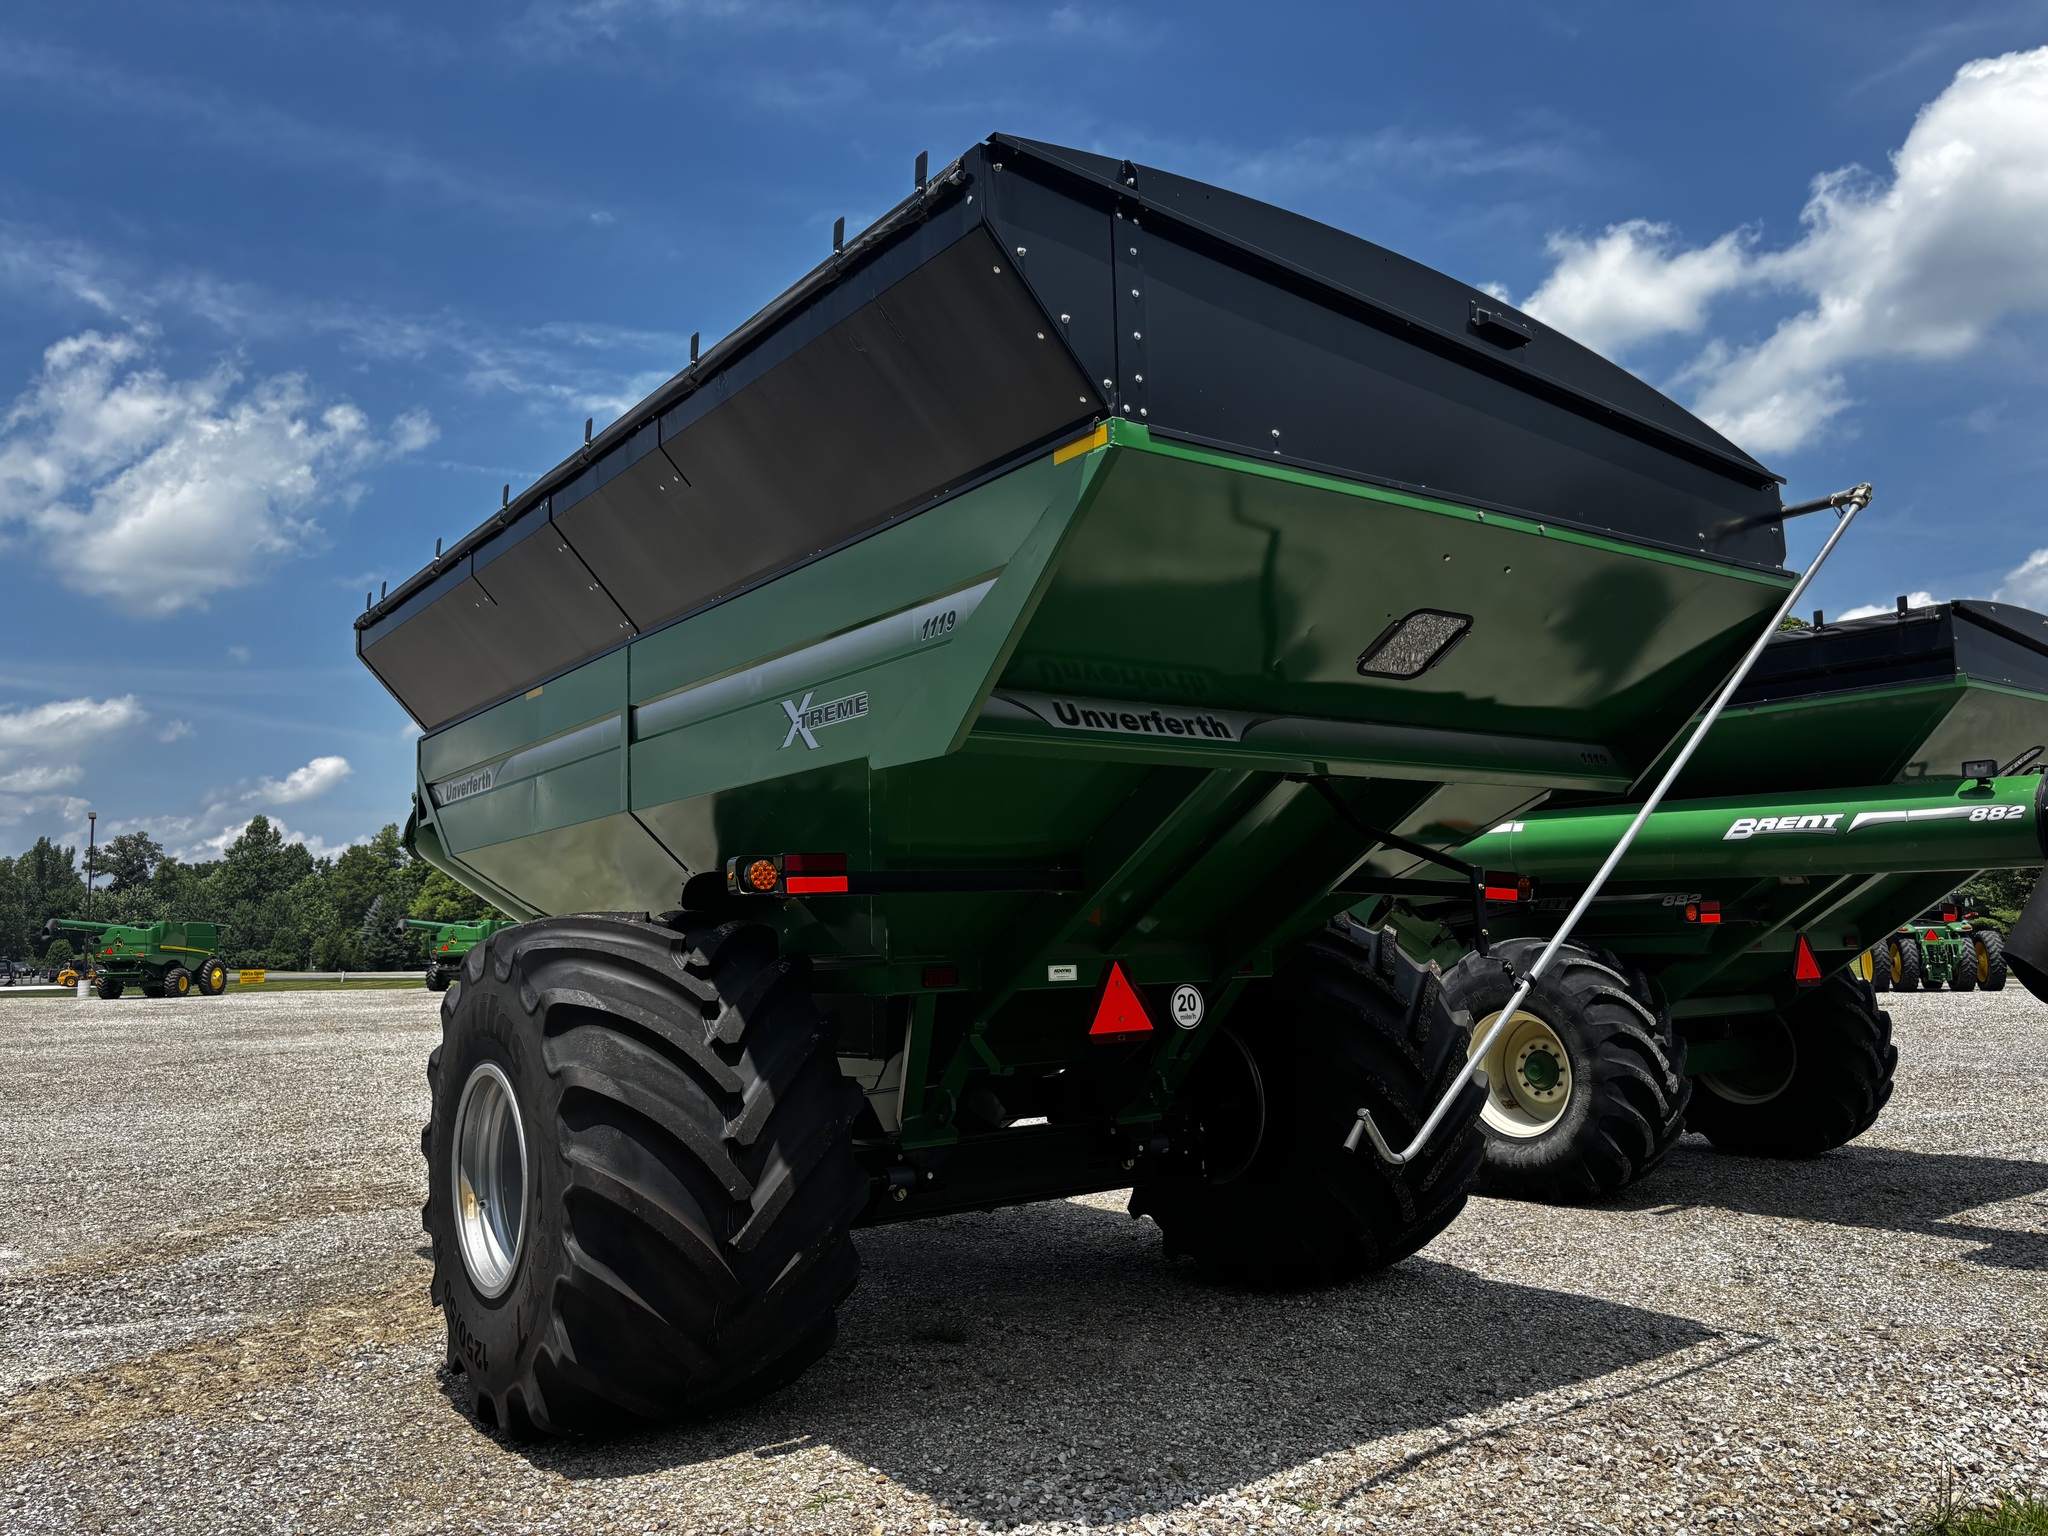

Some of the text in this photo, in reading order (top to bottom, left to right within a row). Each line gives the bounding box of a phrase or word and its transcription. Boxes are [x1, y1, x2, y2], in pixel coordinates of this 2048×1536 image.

[922, 610, 956, 640] 1119
[776, 690, 868, 750] XTREME
[1052, 701, 1232, 739] Unverferth
[1580, 752, 1608, 765] 1119
[445, 769, 492, 802] Unverferth
[1721, 813, 1846, 841] BRENT
[1968, 805, 2027, 822] 882
[1662, 893, 1702, 906] 882
[1177, 993, 1196, 1012] 20
[444, 1278, 489, 1373] 1250/50
